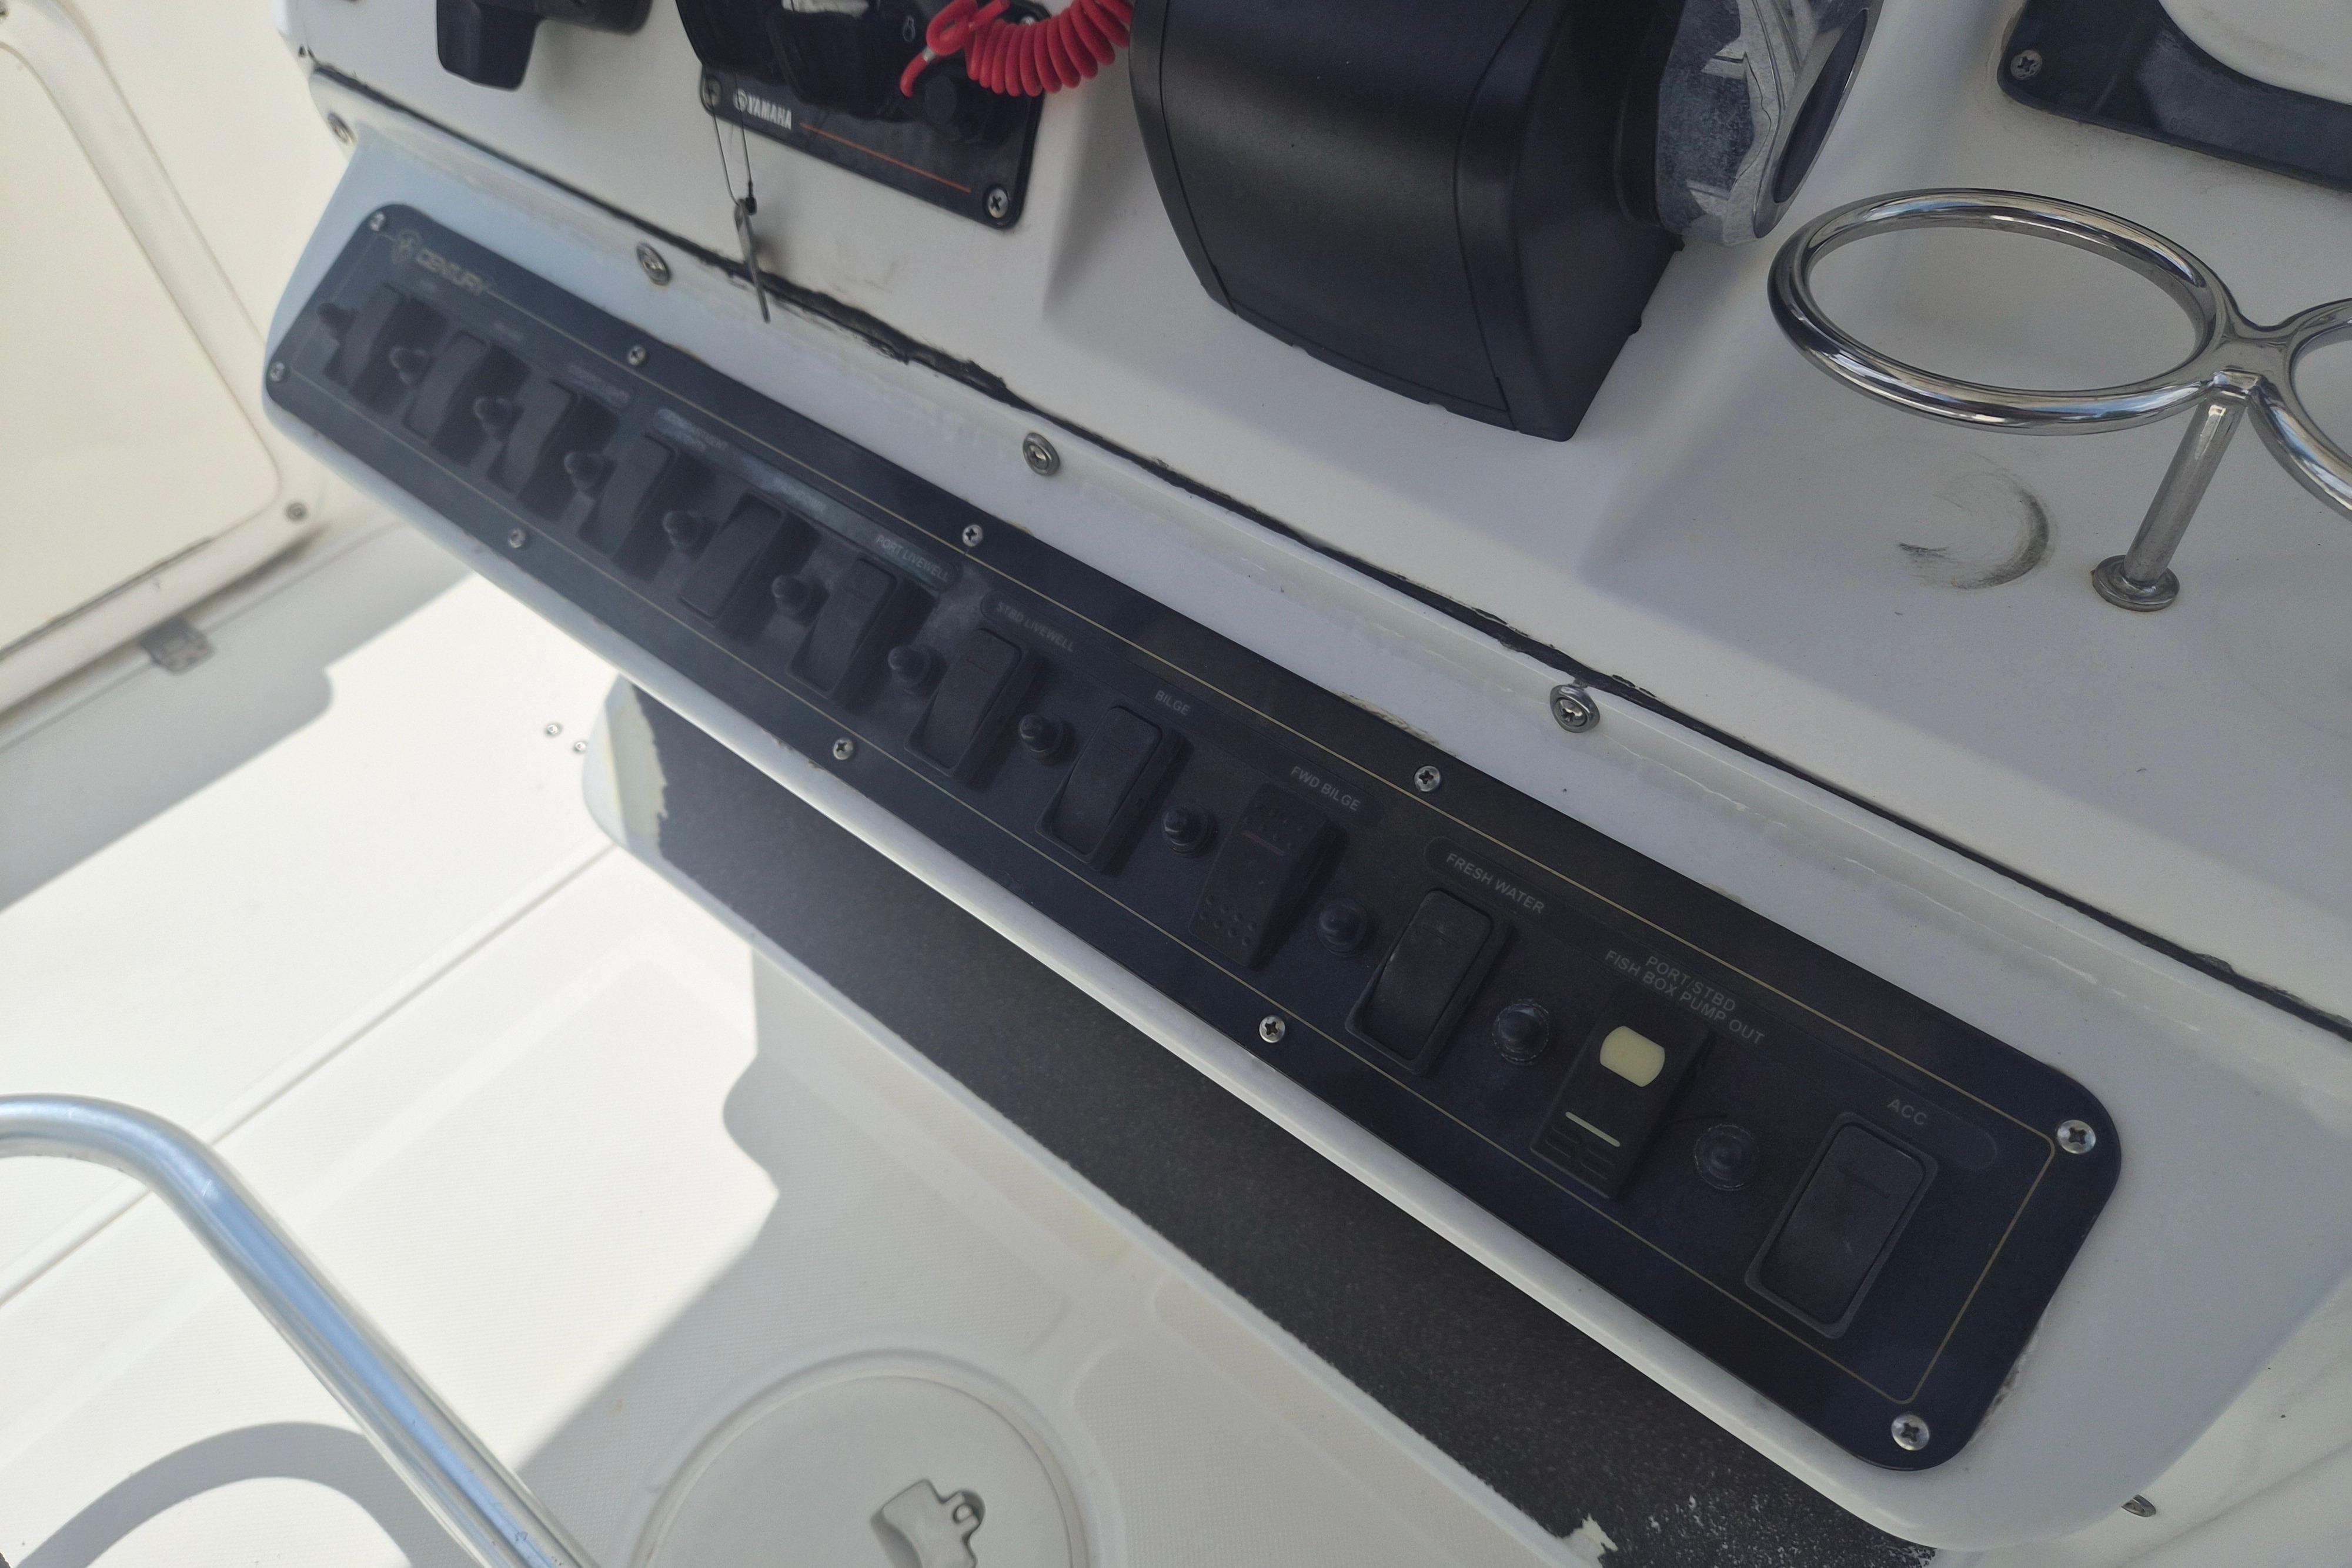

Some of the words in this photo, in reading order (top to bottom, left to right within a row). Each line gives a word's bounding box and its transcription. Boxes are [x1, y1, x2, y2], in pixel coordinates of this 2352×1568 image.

[747, 95, 791, 130] YAMAHA
[876, 534, 903, 556] PORT
[903, 549, 950, 583] LIVEWELL
[995, 602, 1025, 624] STBD
[1024, 616, 1074, 653] LIVEWELL
[1154, 690, 1191, 717] BILGE
[1291, 765, 1320, 788] FWD
[1320, 783, 1361, 812] BILGE
[1445, 852, 1494, 886] FRESH
[1494, 878, 1546, 914] WATER
[1605, 950, 1641, 976] FISH
[1642, 969, 1676, 998] BOX
[1679, 990, 1726, 1023] PUMP
[1729, 1019, 1765, 1045] OUT
[1646, 955, 1736, 1012] PORT/STBD
[1887, 1097, 1927, 1126] ACC
